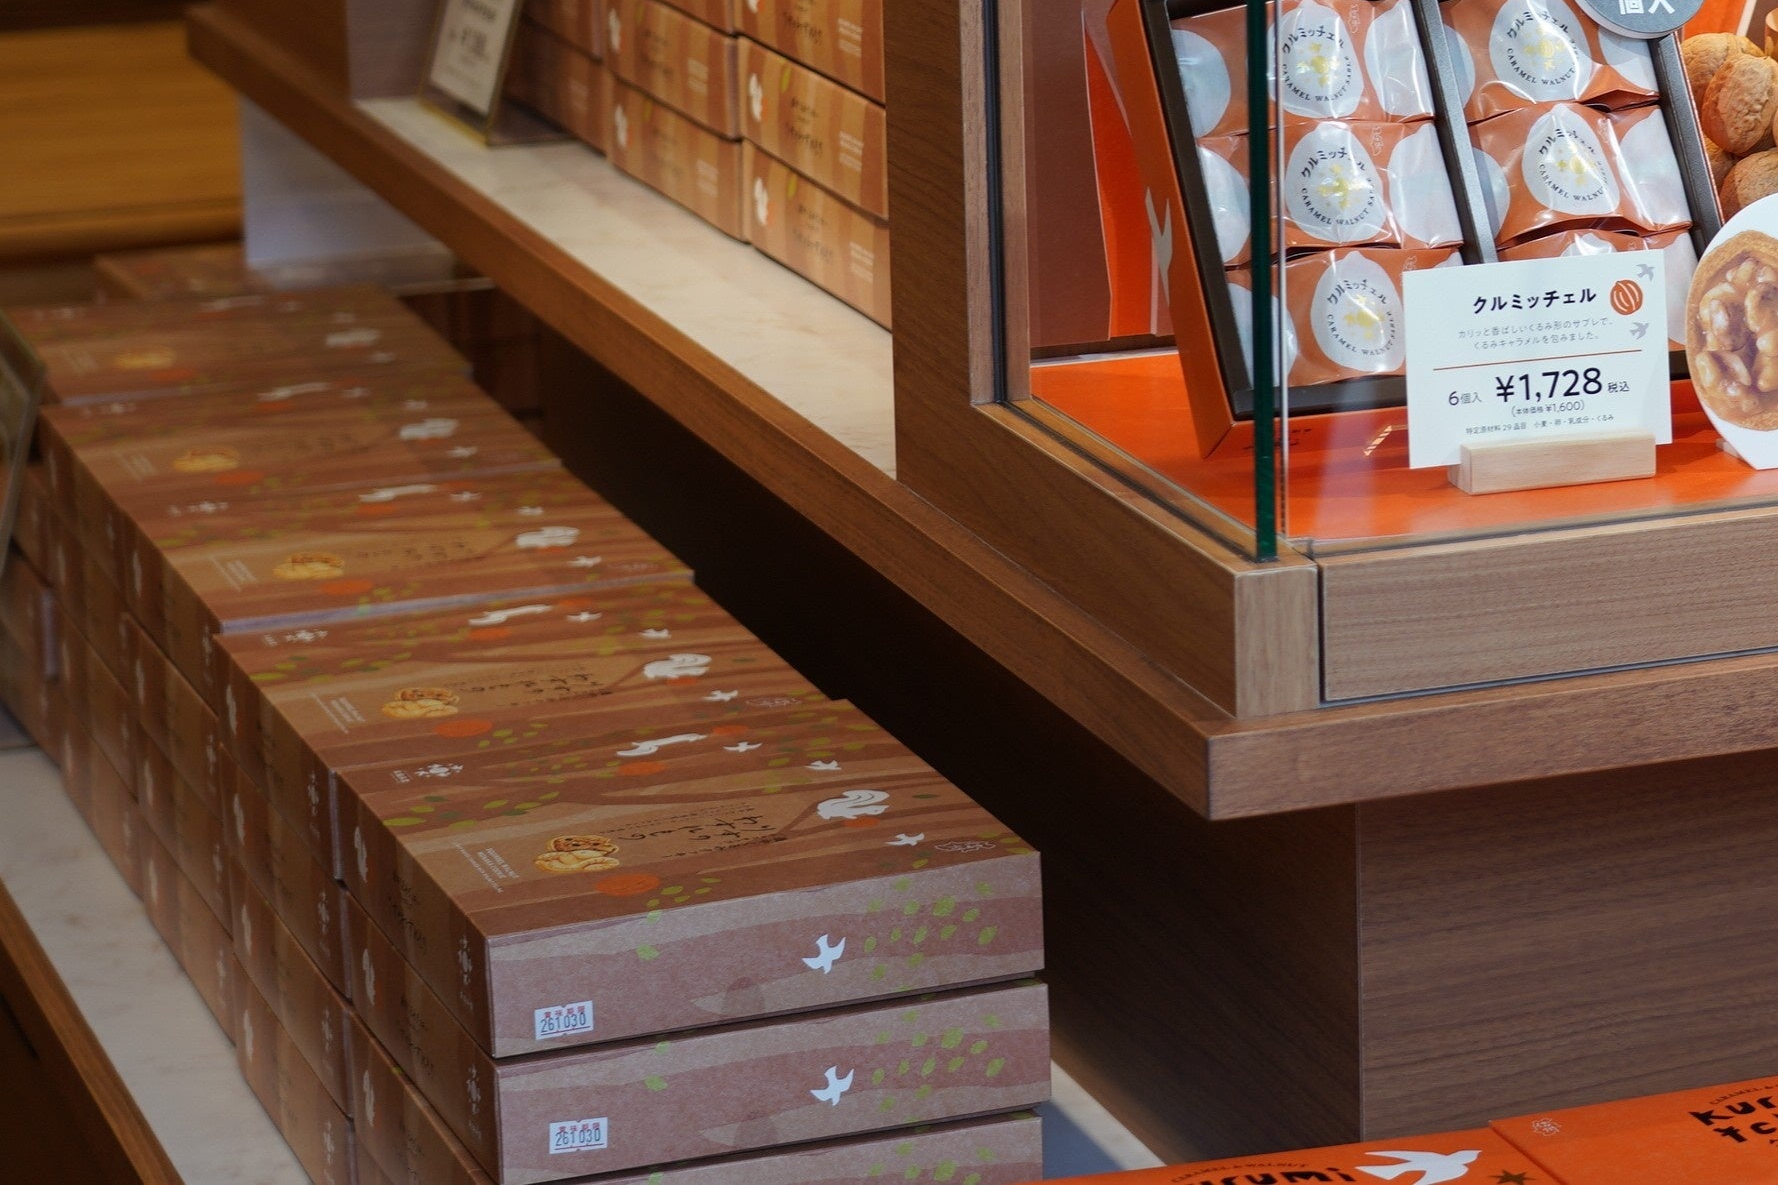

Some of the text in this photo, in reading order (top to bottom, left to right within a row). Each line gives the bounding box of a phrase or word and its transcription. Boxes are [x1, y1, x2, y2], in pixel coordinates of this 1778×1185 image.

[1507, 11, 1569, 39] クルミチェル
[1507, 48, 1575, 85] CARAMEL WALNUT
[1301, 147, 1366, 178] クルミッチル
[1301, 188, 1332, 225] CARAMEL
[1473, 288, 1596, 314] クルミッチェル
[1448, 368, 1630, 406] 6個入 ¥1,728 税込
[540, 1012, 586, 1033] 261030
[1186, 1167, 1356, 1185] rumi
